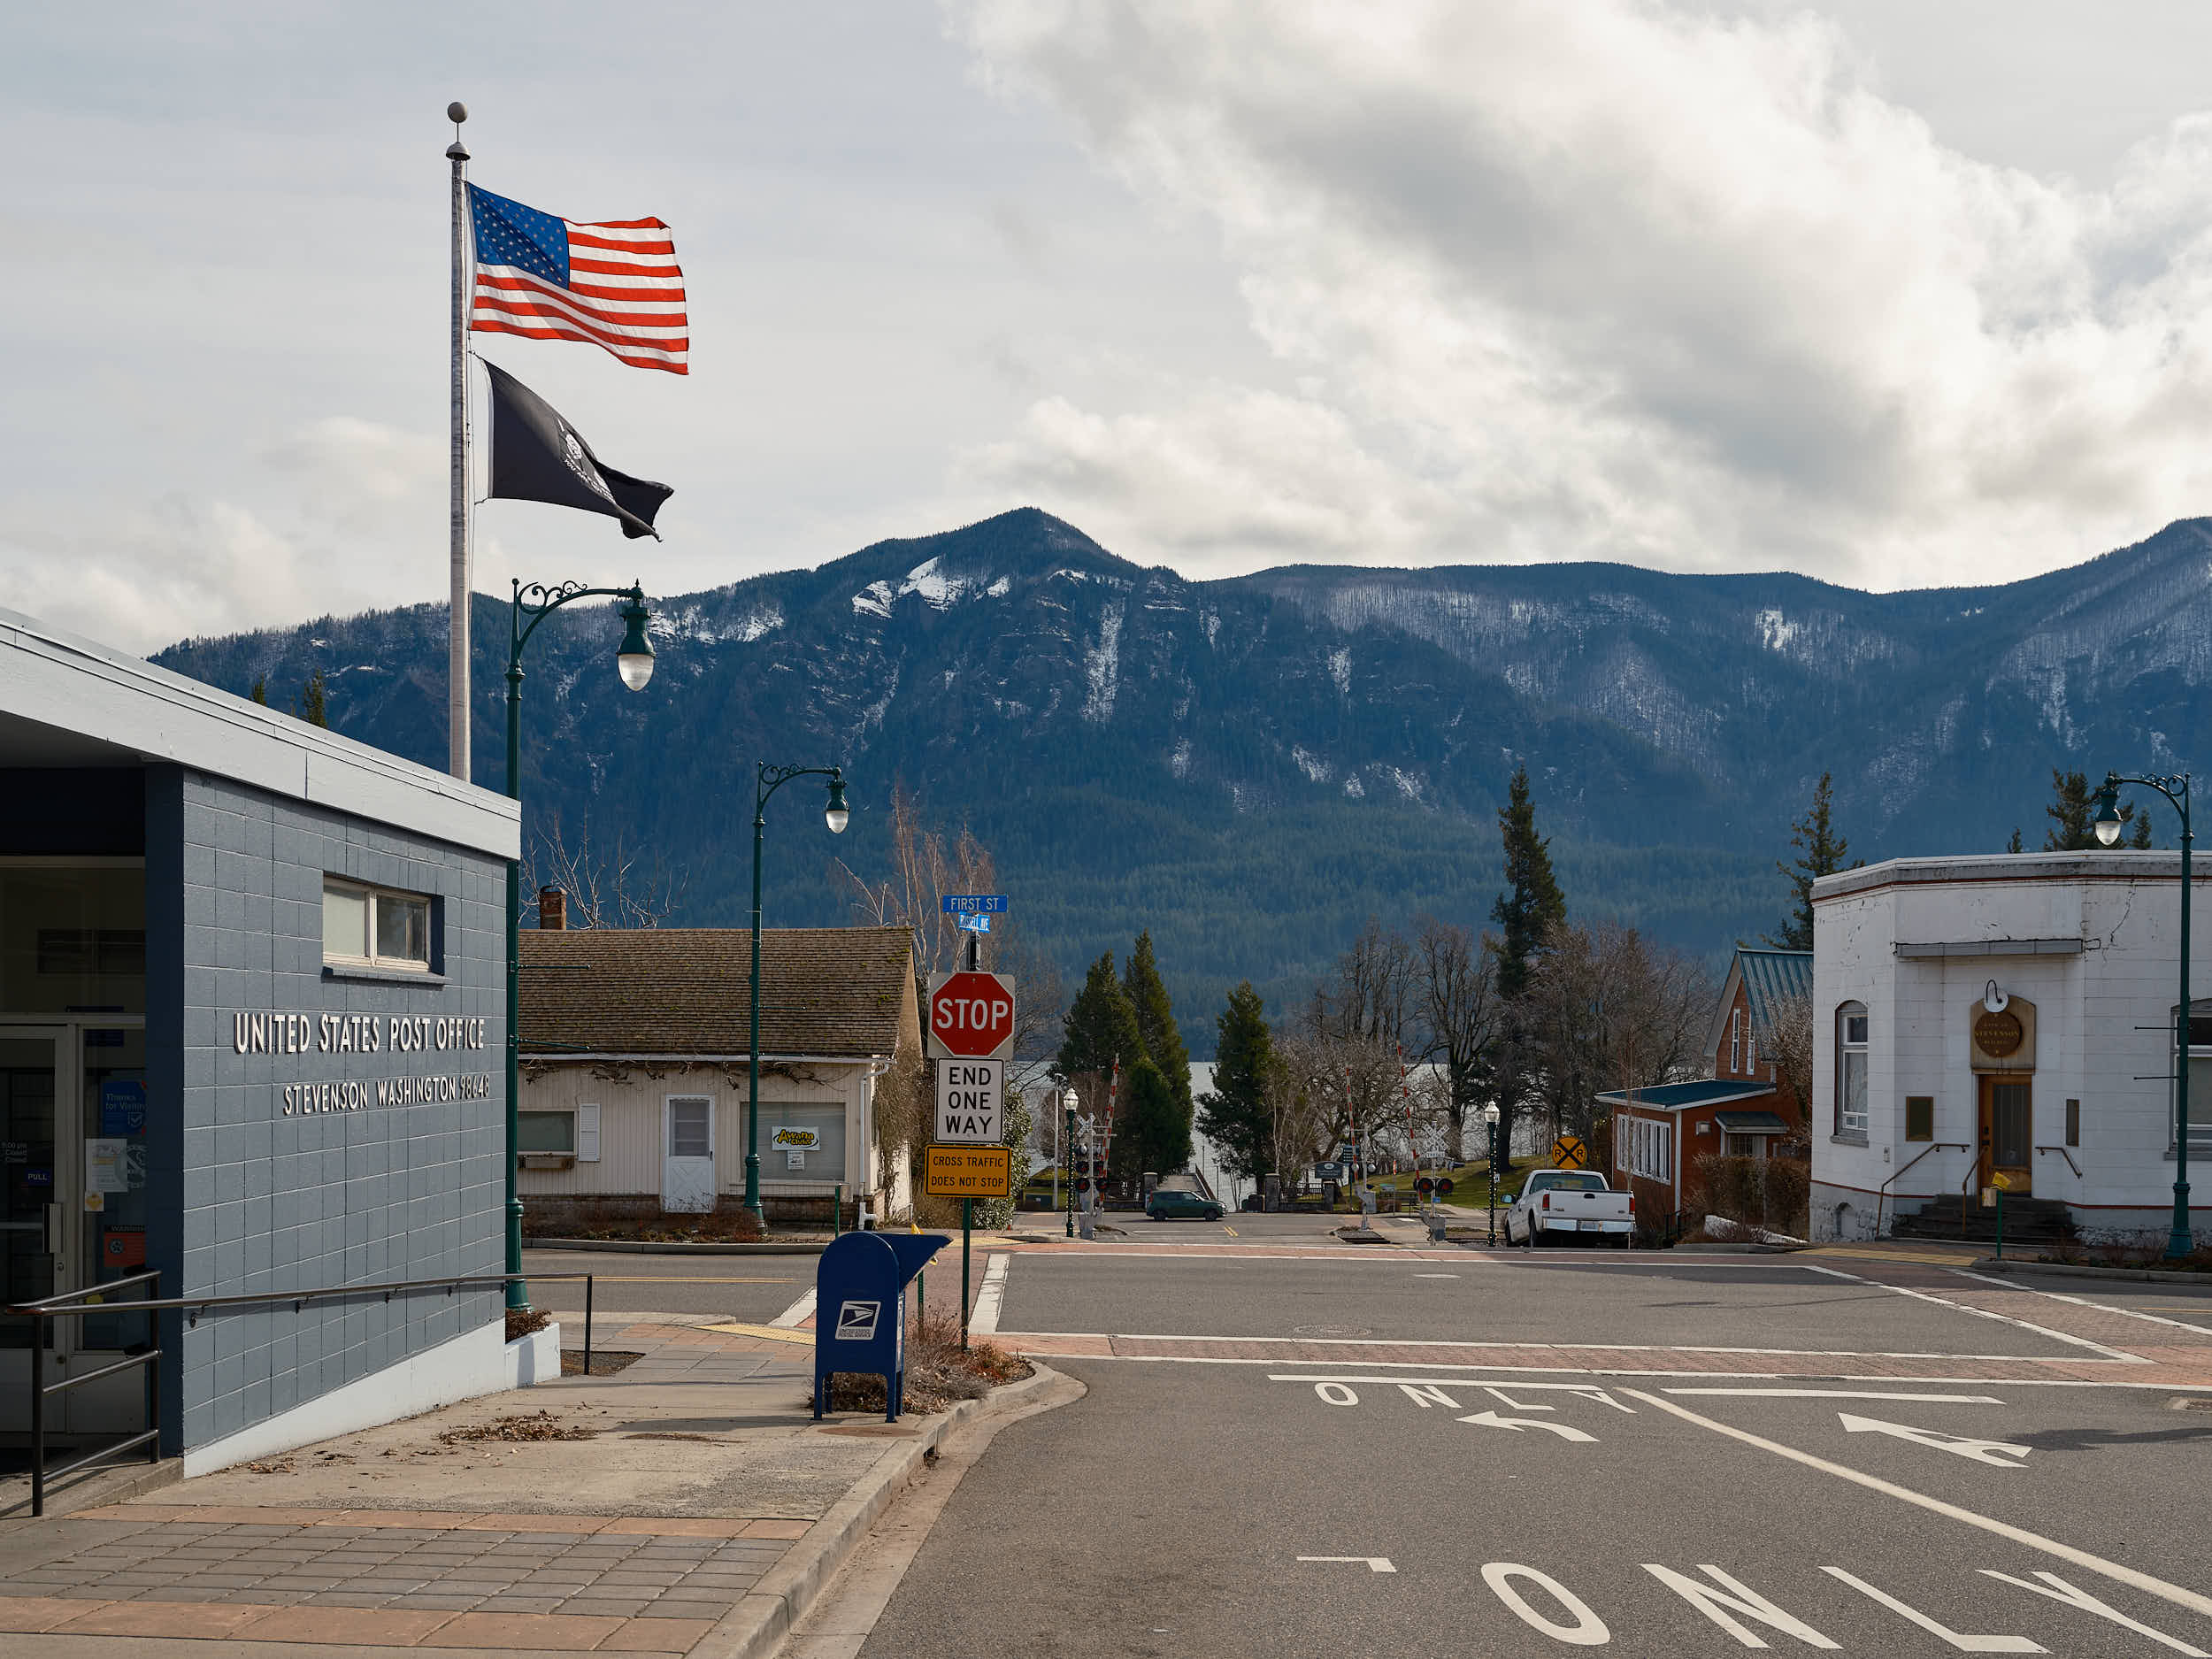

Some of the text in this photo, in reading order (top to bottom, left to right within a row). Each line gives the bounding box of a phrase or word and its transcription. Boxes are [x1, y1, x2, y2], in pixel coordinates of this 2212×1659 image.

[565, 459, 576, 471] YOU
[951, 897, 999, 910] FIRST ST
[936, 997, 1009, 1031] STOP
[234, 1012, 484, 1054] UNITED STATES POST OFFICE
[949, 1066, 992, 1086] END
[283, 1074, 490, 1116] STEVENSON WASHINGTON 98648
[948, 1091, 992, 1110] ONE
[945, 1115, 993, 1134] WAY
[777, 1128, 815, 1144] Awana
[933, 1156, 1004, 1168] CROSS TRAFFIC
[1555, 1148, 1584, 1157] R R
[931, 1175, 1004, 1187] DOES NOT STOP
[1314, 1382, 1639, 1414] ONLY
[1481, 1562, 2212, 1657] ONLY
